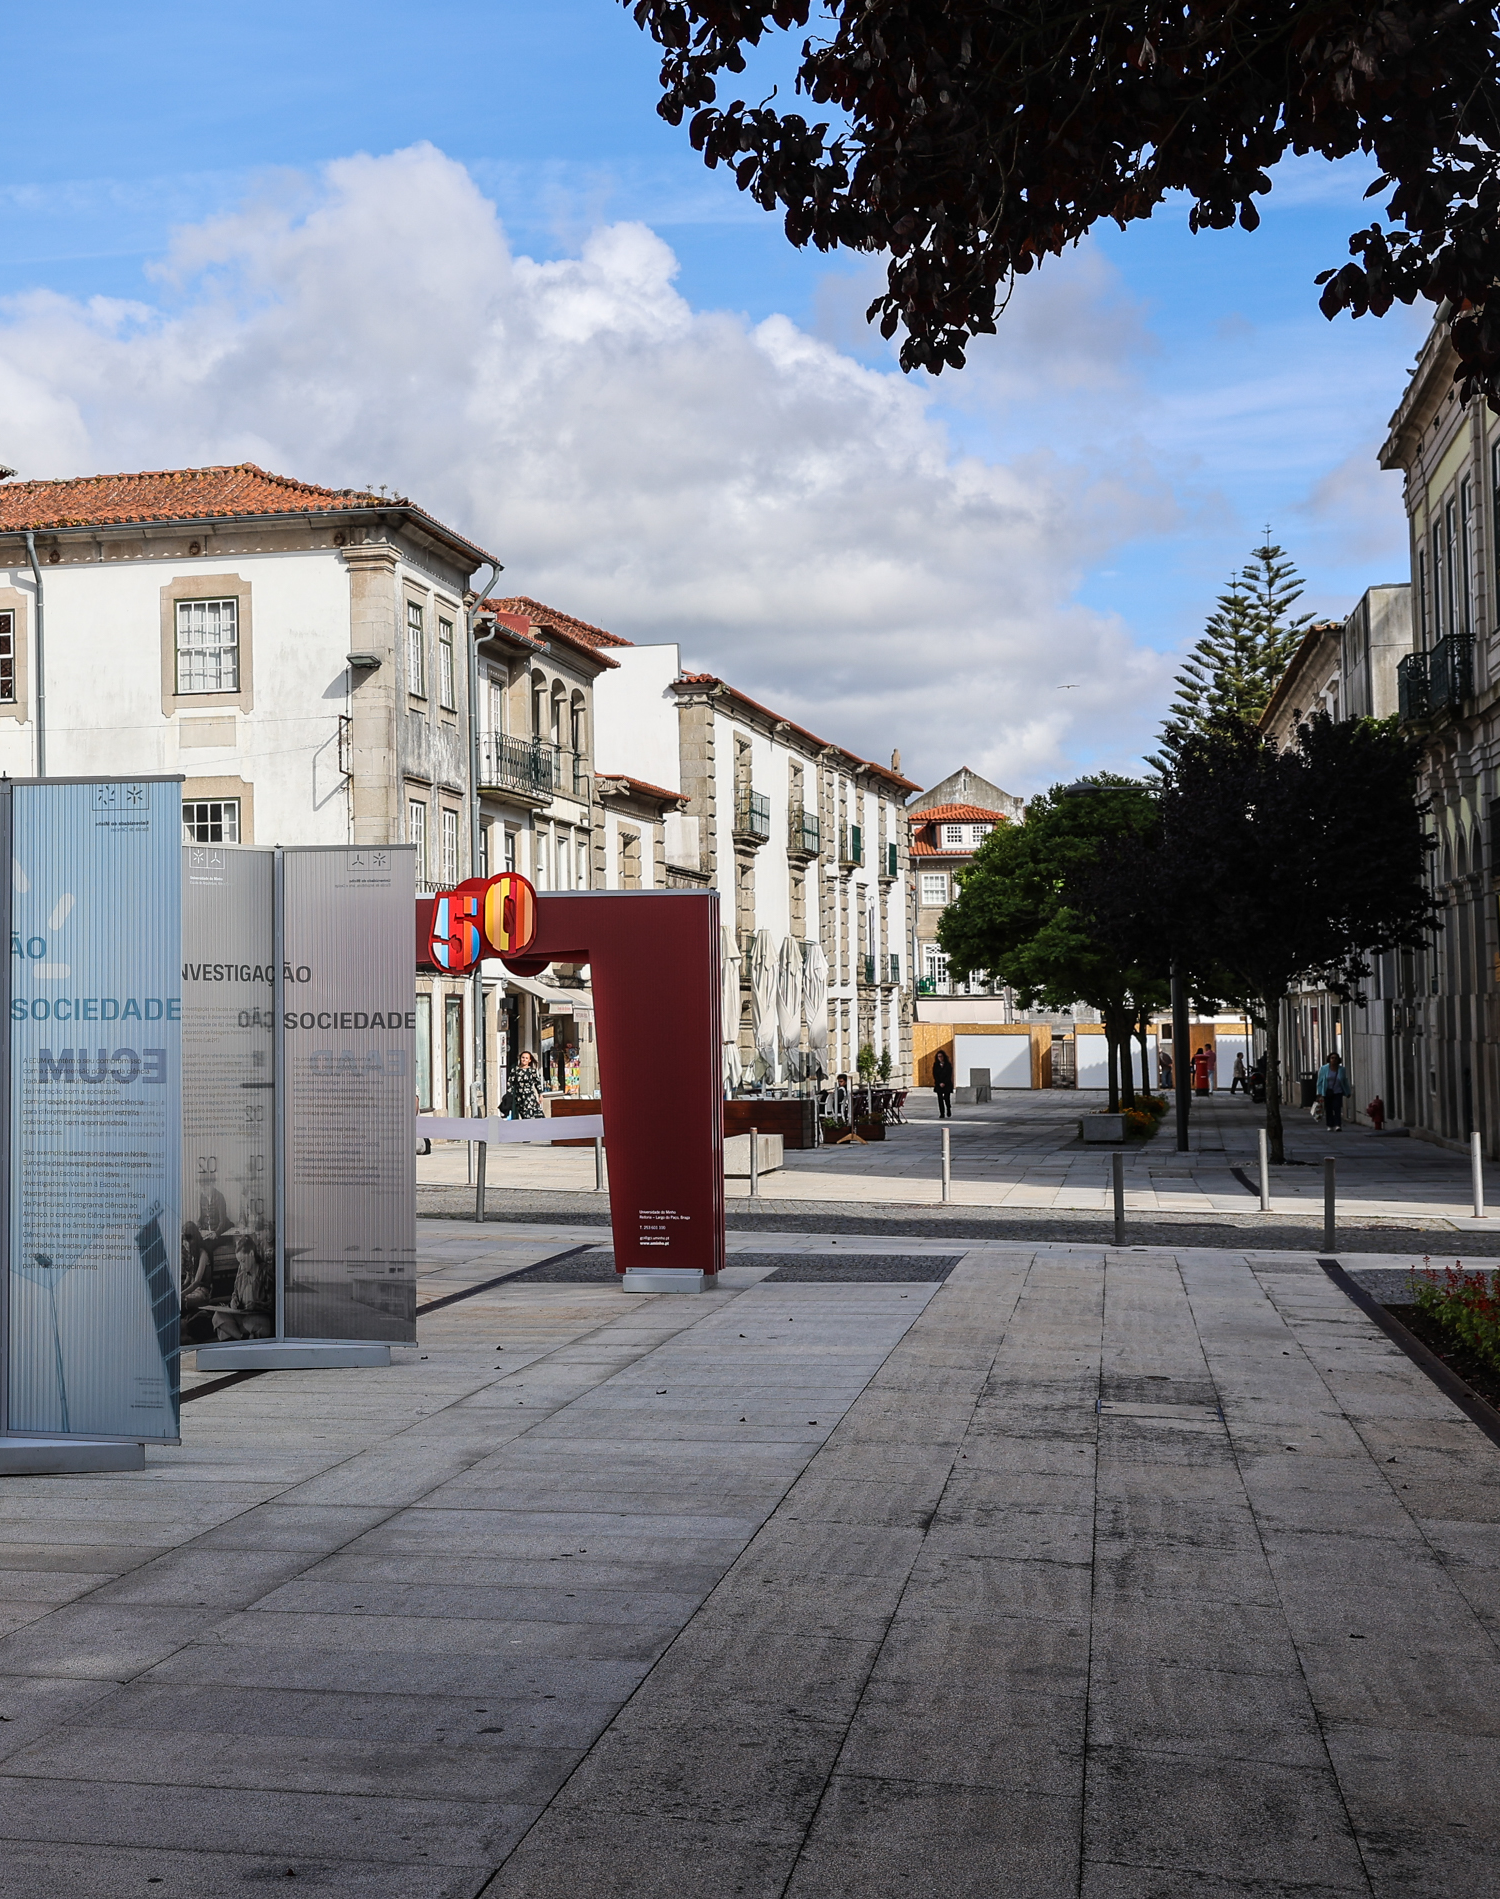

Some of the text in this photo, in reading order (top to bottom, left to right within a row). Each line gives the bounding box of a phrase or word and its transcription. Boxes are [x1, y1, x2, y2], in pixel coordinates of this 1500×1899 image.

[430, 875, 535, 972] 50
[182, 961, 311, 986] NVESTIGAÇÃO
[10, 998, 181, 1021] SOCIEDADE
[284, 1012, 416, 1029] SOCIEDADE
